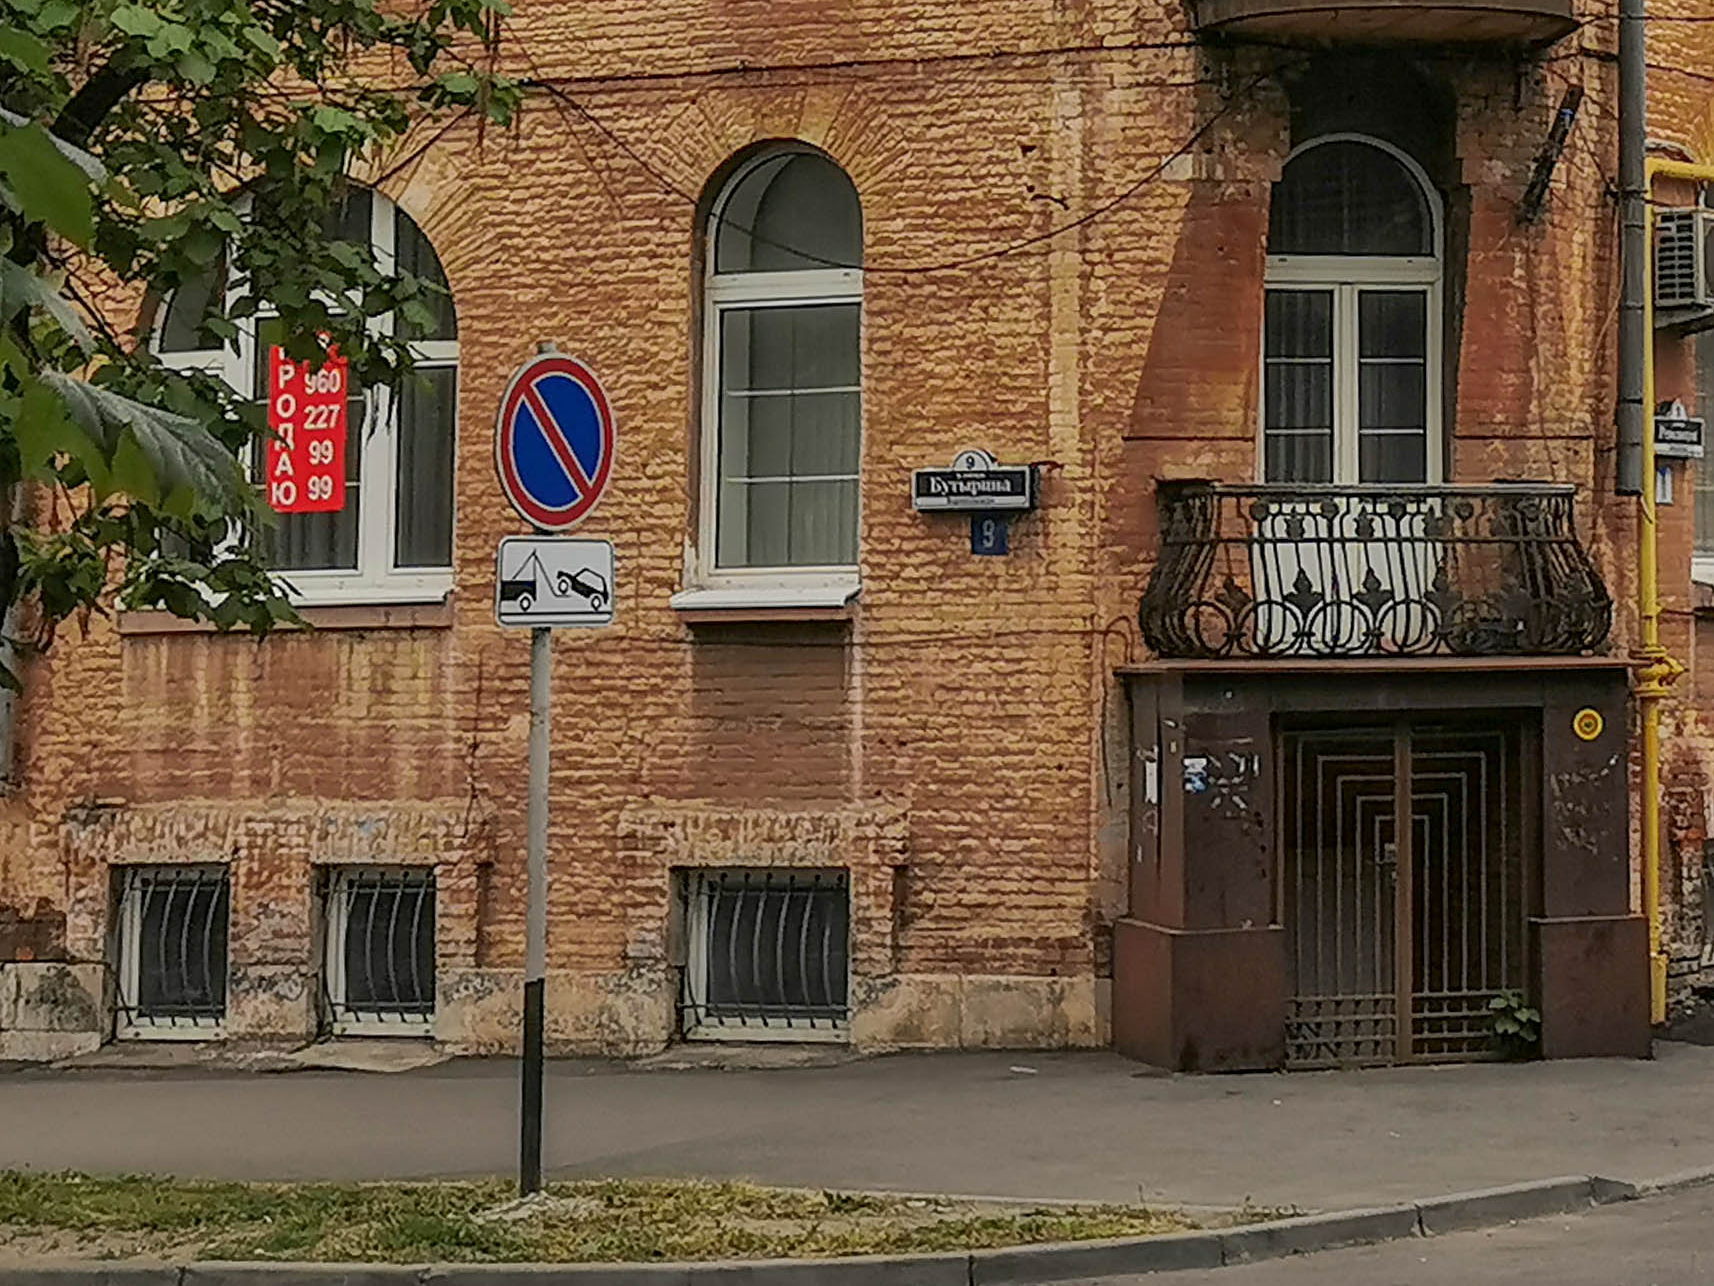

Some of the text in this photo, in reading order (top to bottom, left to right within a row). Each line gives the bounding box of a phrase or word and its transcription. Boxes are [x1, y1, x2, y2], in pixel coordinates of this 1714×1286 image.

[303, 404, 340, 430] 227
[308, 439, 334, 466] 99
[307, 475, 333, 501] 99
